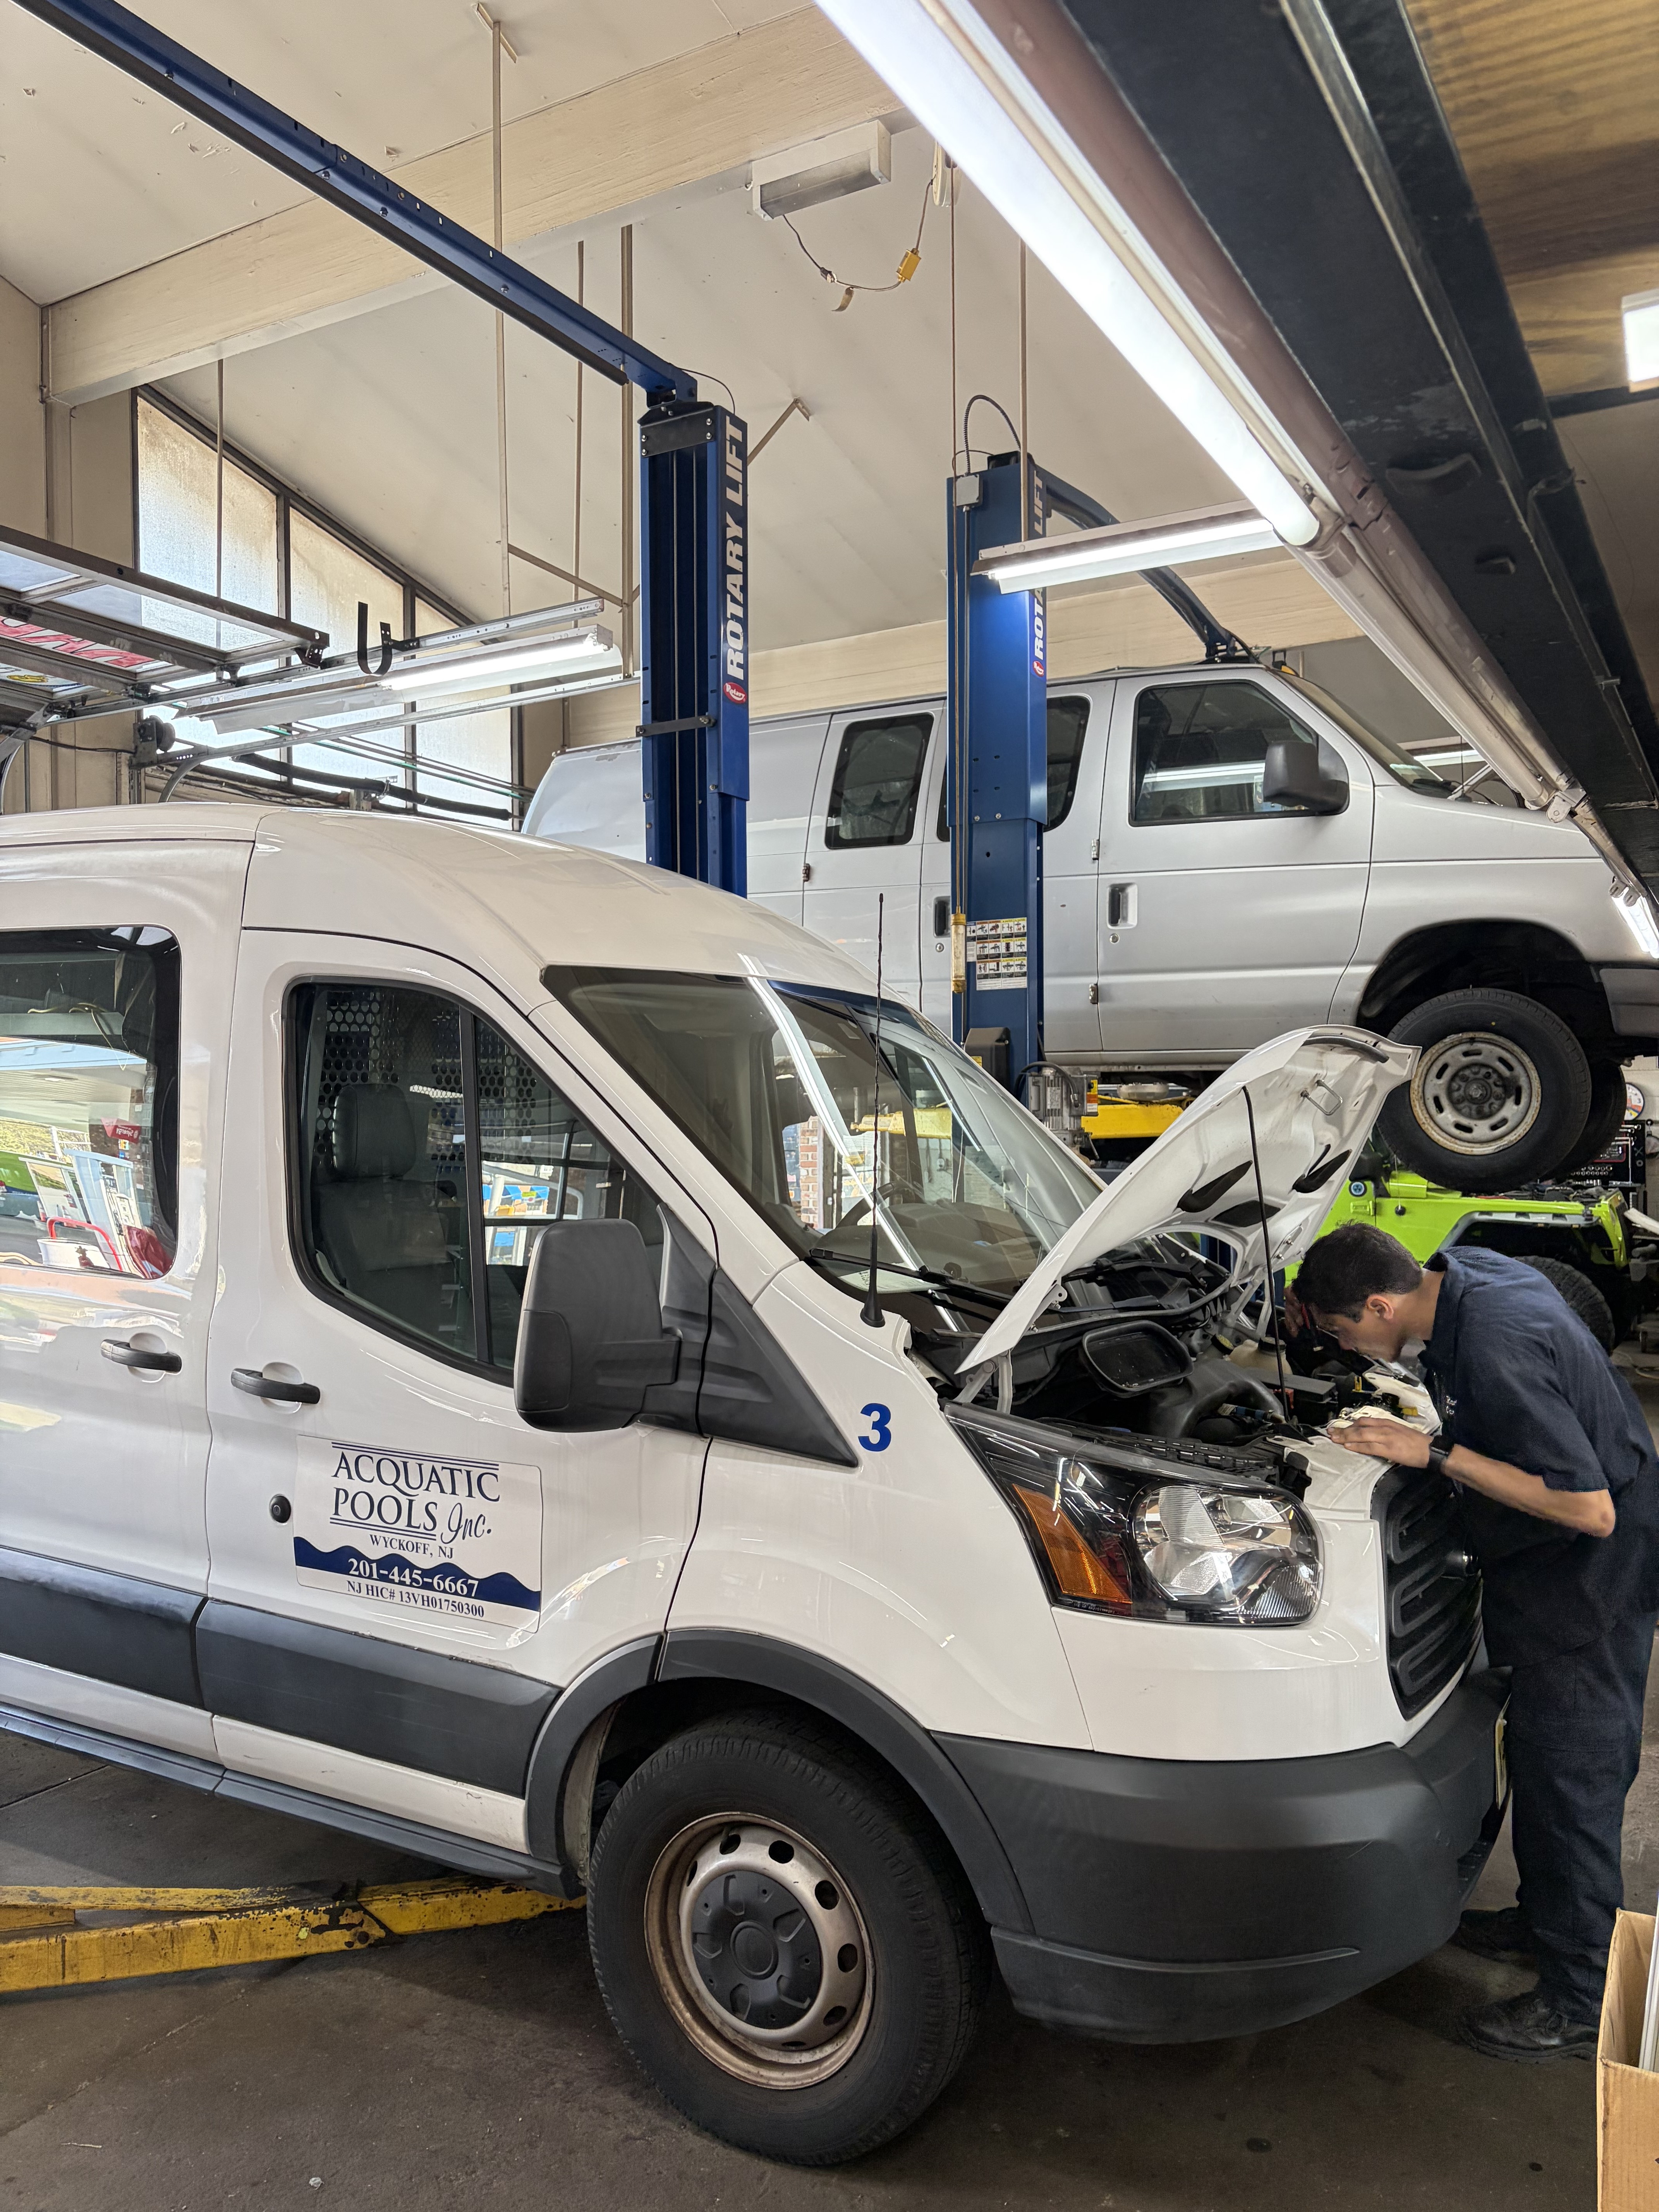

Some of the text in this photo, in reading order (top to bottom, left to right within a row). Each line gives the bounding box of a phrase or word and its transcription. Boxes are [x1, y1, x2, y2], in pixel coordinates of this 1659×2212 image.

[1034, 471, 1042, 535] LIFT
[726, 416, 744, 680] ROTARY LIFT
[1034, 588, 1043, 660] ROTA
[857, 1403, 891, 1452] 3
[331, 1451, 500, 1502] ACQUATIC
[332, 1487, 492, 1544] POOLS Inc.
[369, 1534, 454, 1559] WYCKOFF, NJ
[346, 1580, 485, 1618] NJ HIC# 13VH01750300
[348, 1558, 479, 1597] 201-445-6667
